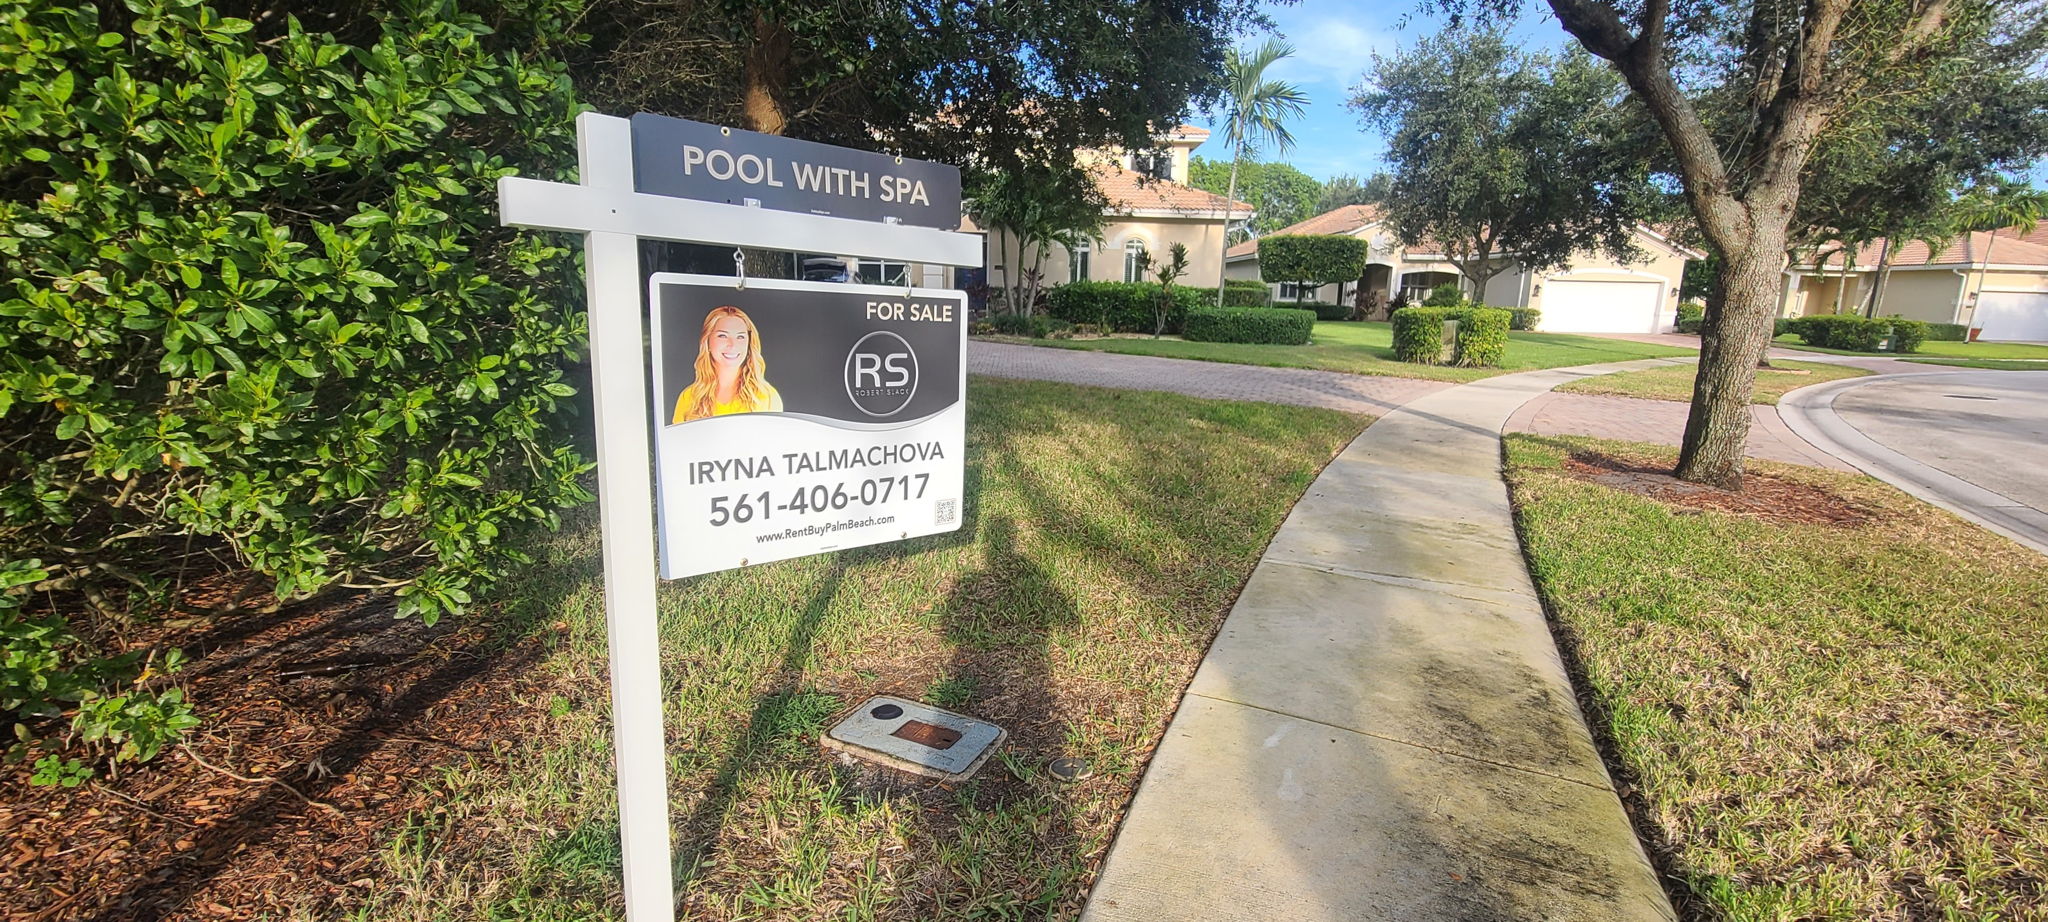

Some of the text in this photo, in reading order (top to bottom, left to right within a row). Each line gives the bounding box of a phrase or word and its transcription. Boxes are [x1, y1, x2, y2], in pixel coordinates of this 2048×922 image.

[683, 145, 930, 207] POOL WITH SPA
[866, 302, 953, 322] FOR SALE
[855, 353, 909, 388] RS
[855, 389, 884, 397] ROBERT
[689, 441, 944, 485] IRYNA TALMACHOVA
[709, 473, 930, 527] 561-406-0717
[756, 515, 895, 544] www.RentBuyPalmBeach.com
